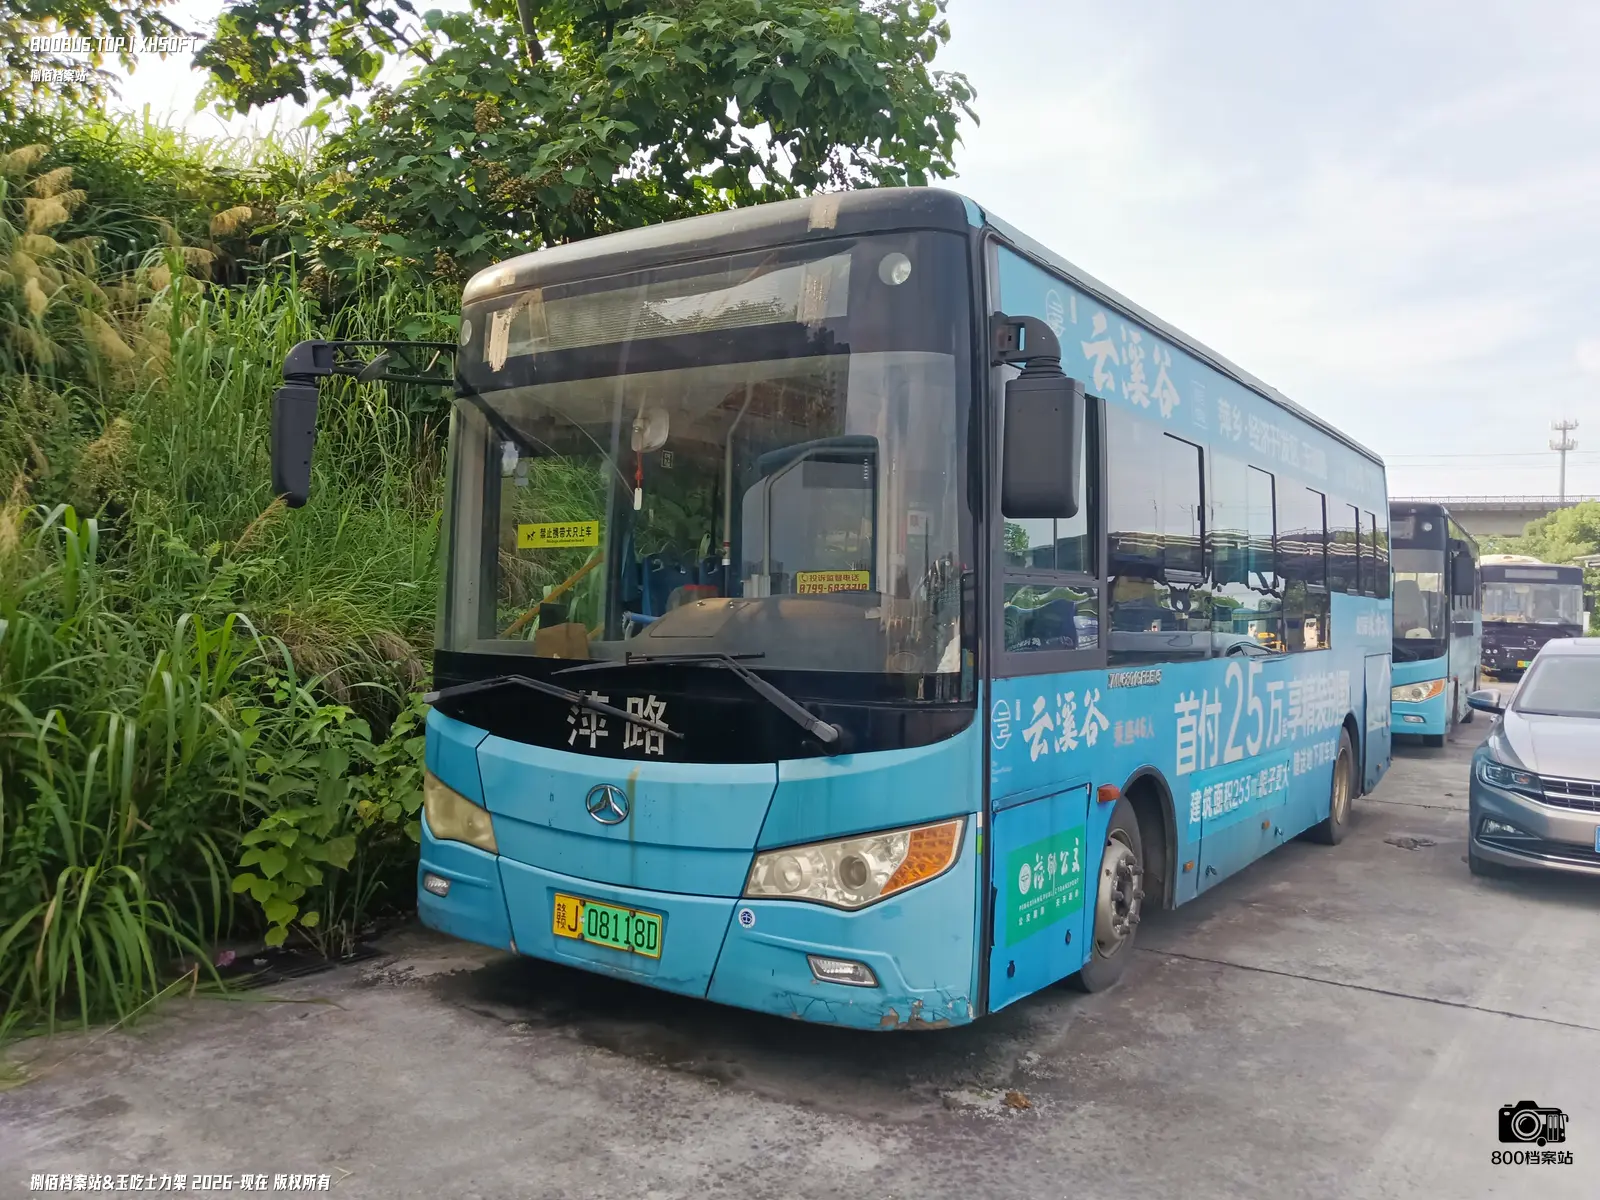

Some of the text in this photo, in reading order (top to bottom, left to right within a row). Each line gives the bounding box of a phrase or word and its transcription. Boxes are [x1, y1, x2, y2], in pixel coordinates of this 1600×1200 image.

[1082, 312, 1181, 419] 云溪谷
[540, 526, 592, 539] 禁止携带犬只上车
[1022, 687, 1109, 762] 云溪谷
